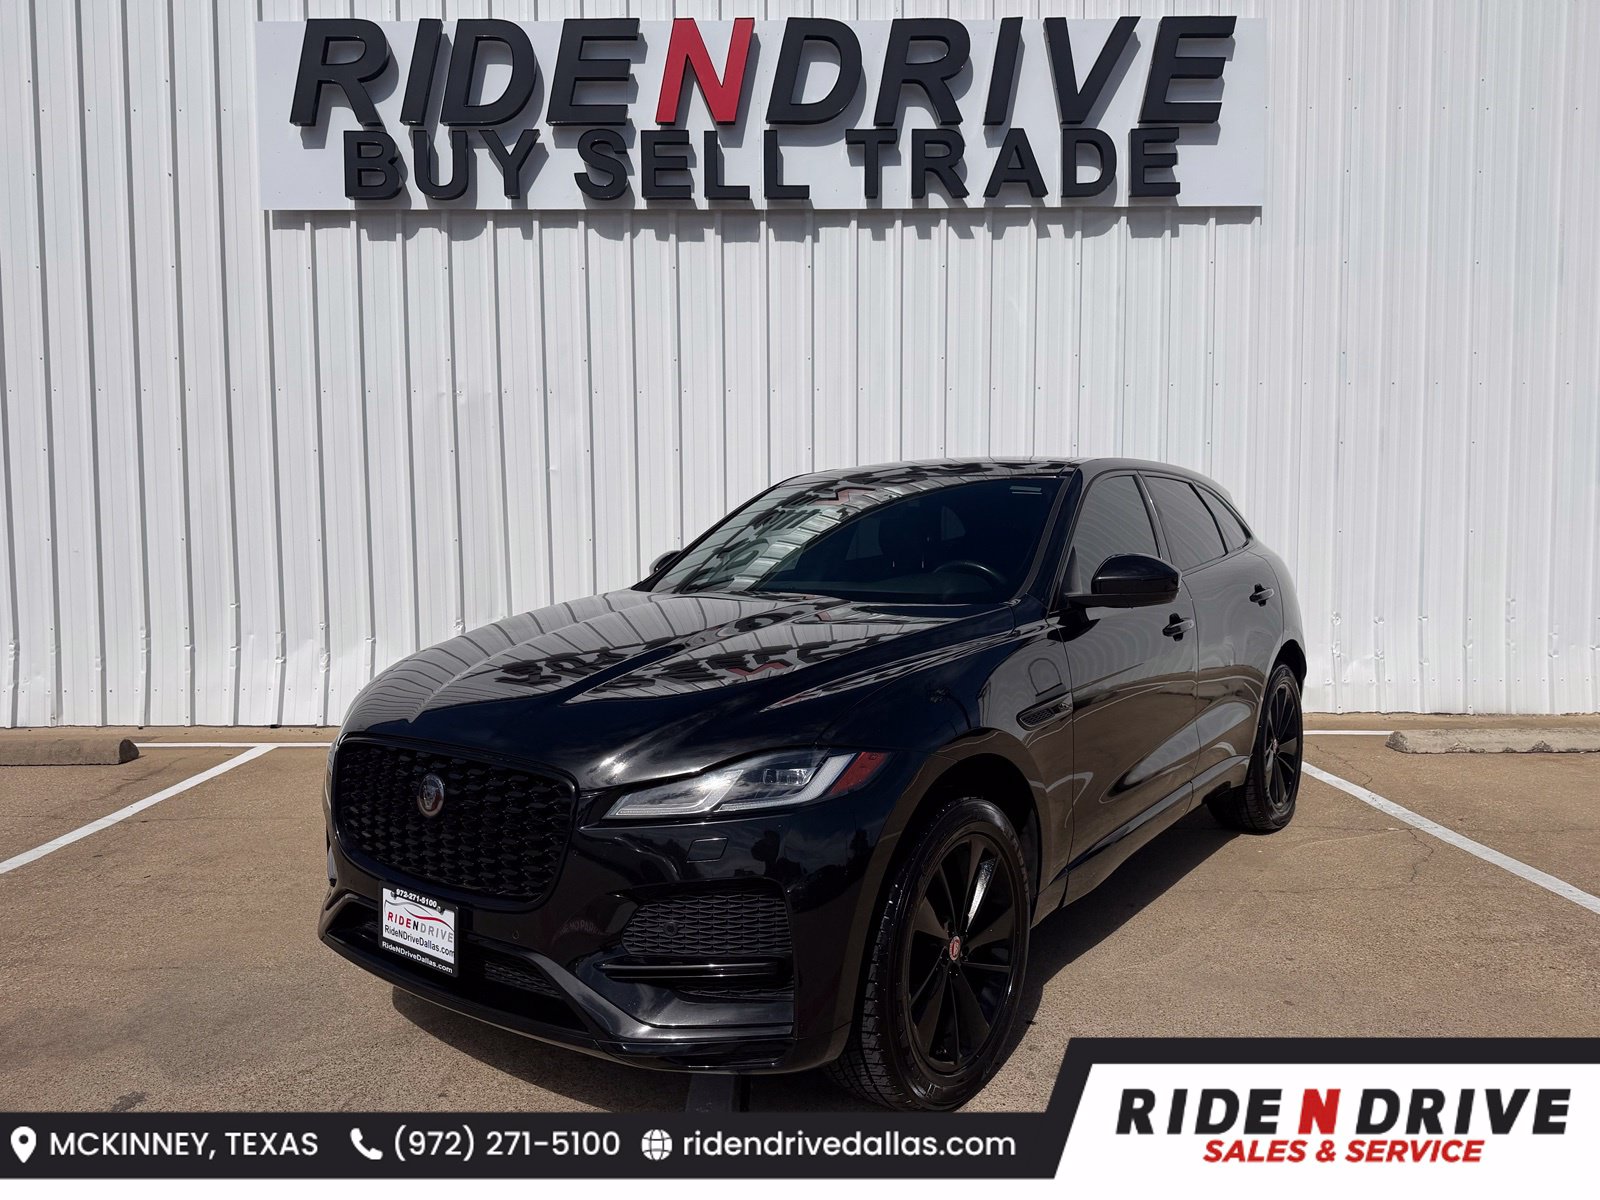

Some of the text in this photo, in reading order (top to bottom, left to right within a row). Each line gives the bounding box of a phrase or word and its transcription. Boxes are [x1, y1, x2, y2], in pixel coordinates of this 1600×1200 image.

[342, 127, 1182, 201] BUY SELL TRADE
[396, 888, 438, 909] 972-271-5100
[387, 911, 454, 944] RIDENDRIVE
[382, 941, 453, 974] RideNDriveDallas.com
